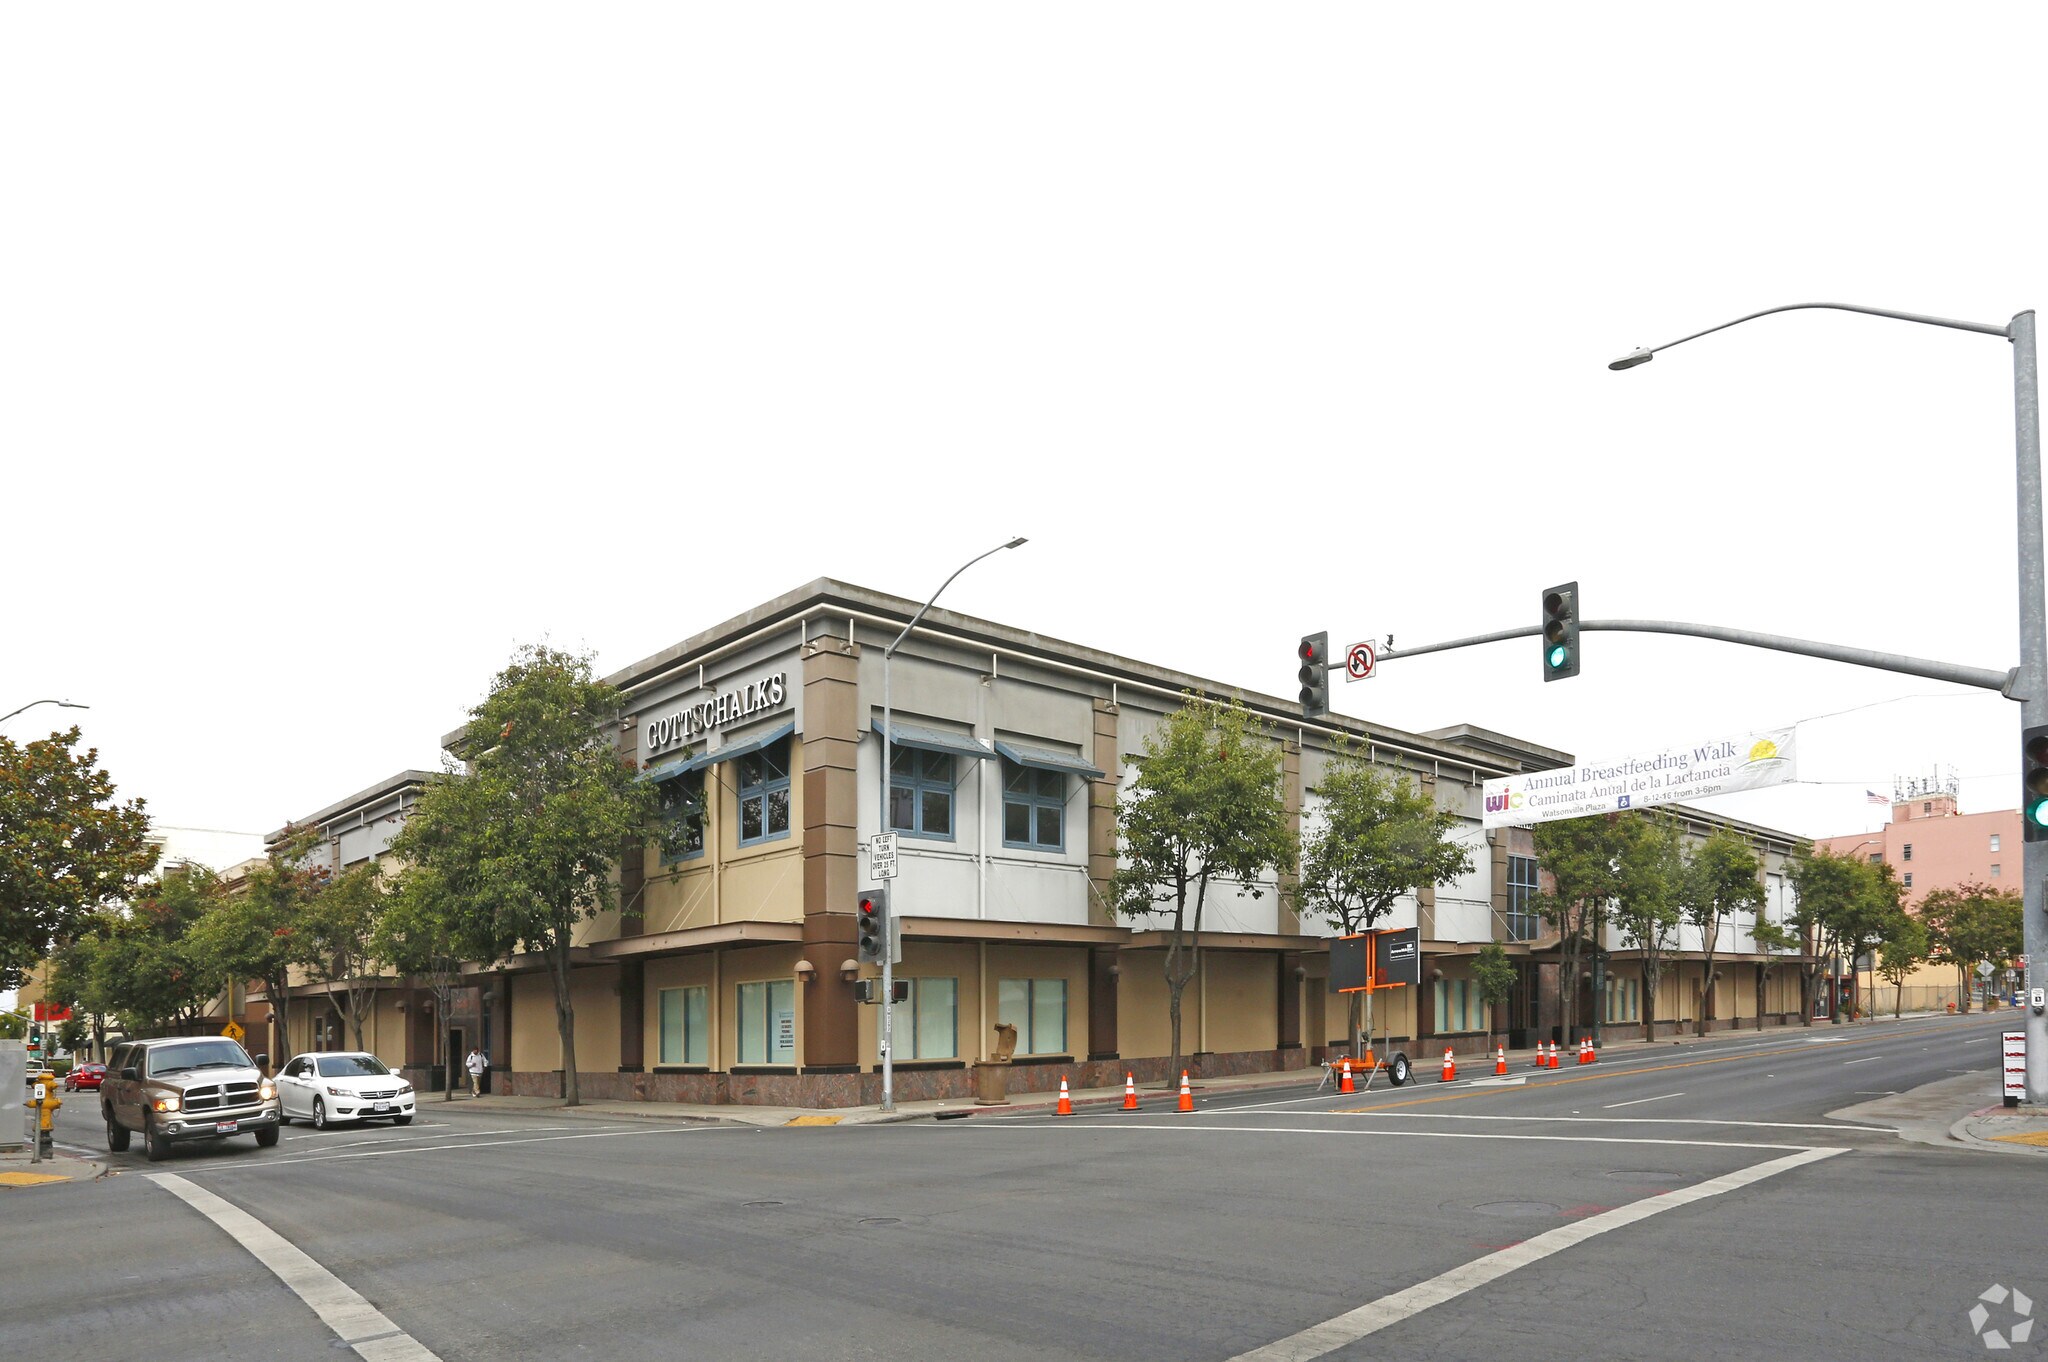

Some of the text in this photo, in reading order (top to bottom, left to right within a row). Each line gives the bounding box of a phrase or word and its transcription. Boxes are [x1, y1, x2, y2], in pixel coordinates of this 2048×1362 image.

[647, 672, 787, 749] GOTTSCHALKS
[1524, 741, 1737, 791] Annual Breastfeeding Walk
[1529, 790, 1586, 807] Caminata
[1589, 780, 1627, 799] Anual
[1630, 779, 1646, 792] de
[1650, 775, 1661, 789] la
[1666, 764, 1731, 786] Lactancia
[1674, 789, 1693, 798] from
[1695, 784, 1722, 795] 3-6pm
[1541, 803, 1606, 818] Watsonville Plaza
[882, 835, 892, 844] LEFT
[874, 852, 894, 860] VEHICLES
[872, 862, 882, 870] OVER
[878, 869, 890, 877] LONG
